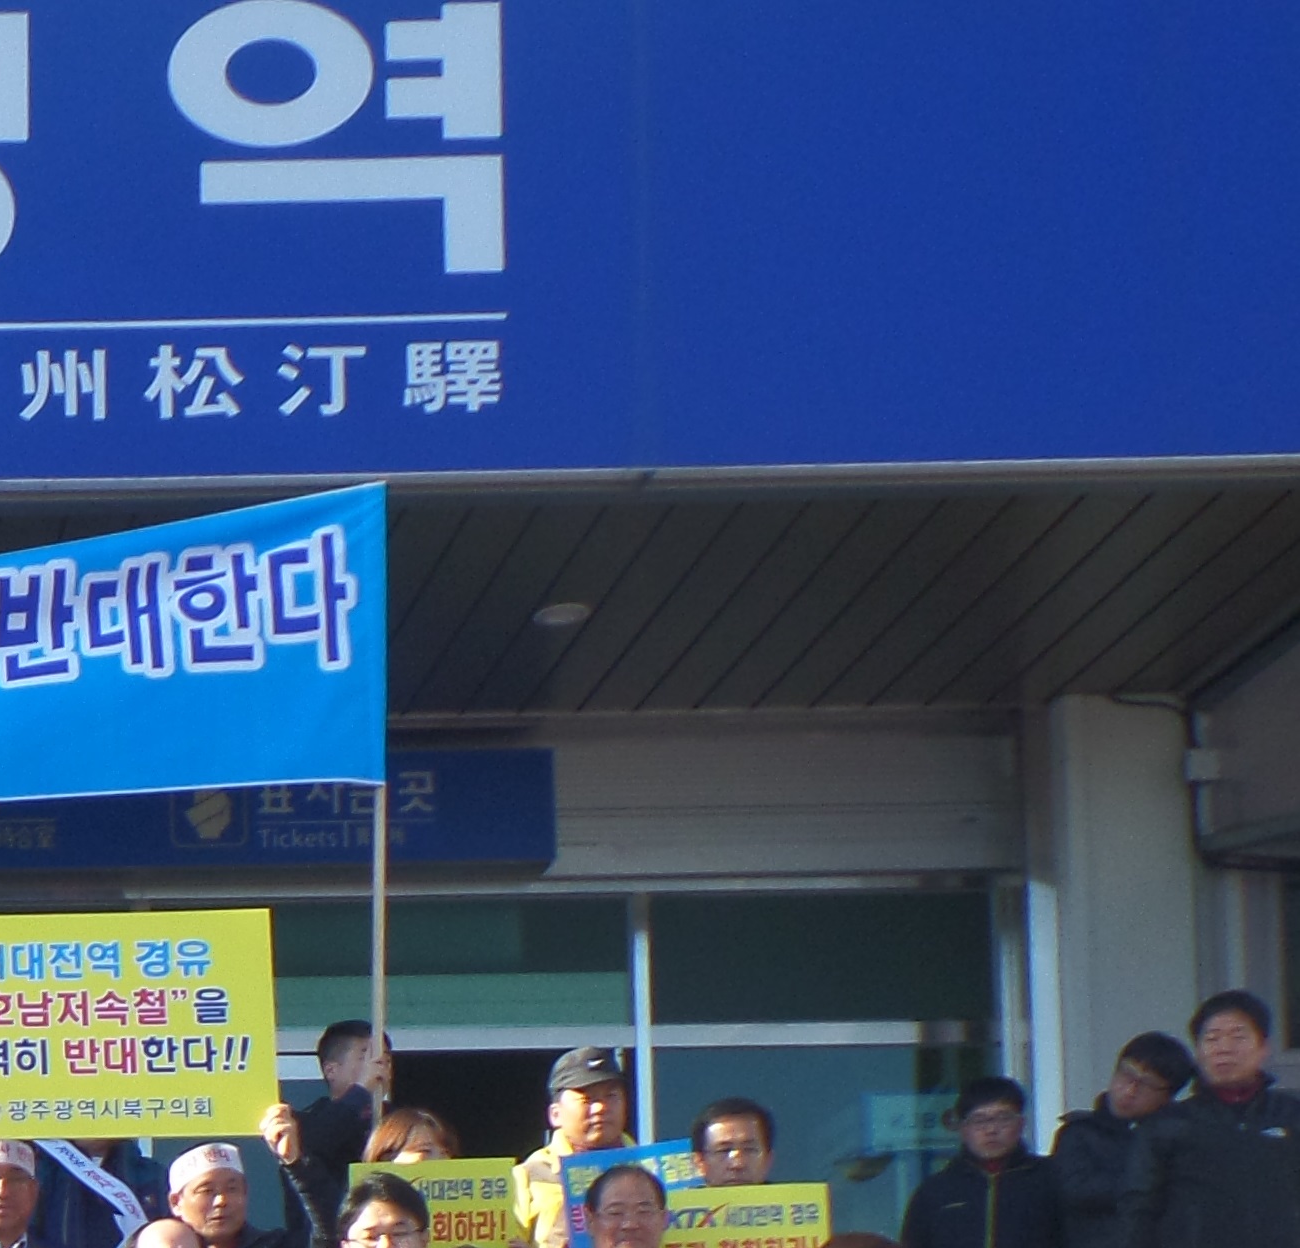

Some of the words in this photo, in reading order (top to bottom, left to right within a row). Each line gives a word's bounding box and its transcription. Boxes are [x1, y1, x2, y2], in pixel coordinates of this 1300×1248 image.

[258, 829, 337, 849] Tickets
[135, 940, 211, 978] 경유
[63, 1036, 248, 1075] 반대한다!!
[8, 1096, 213, 1120] 광주광역시북구의회
[480, 1177, 508, 1200] 경유
[432, 1211, 506, 1241] 회하라!
[725, 1206, 783, 1226] 서대전역
[790, 1203, 819, 1225] 경유
